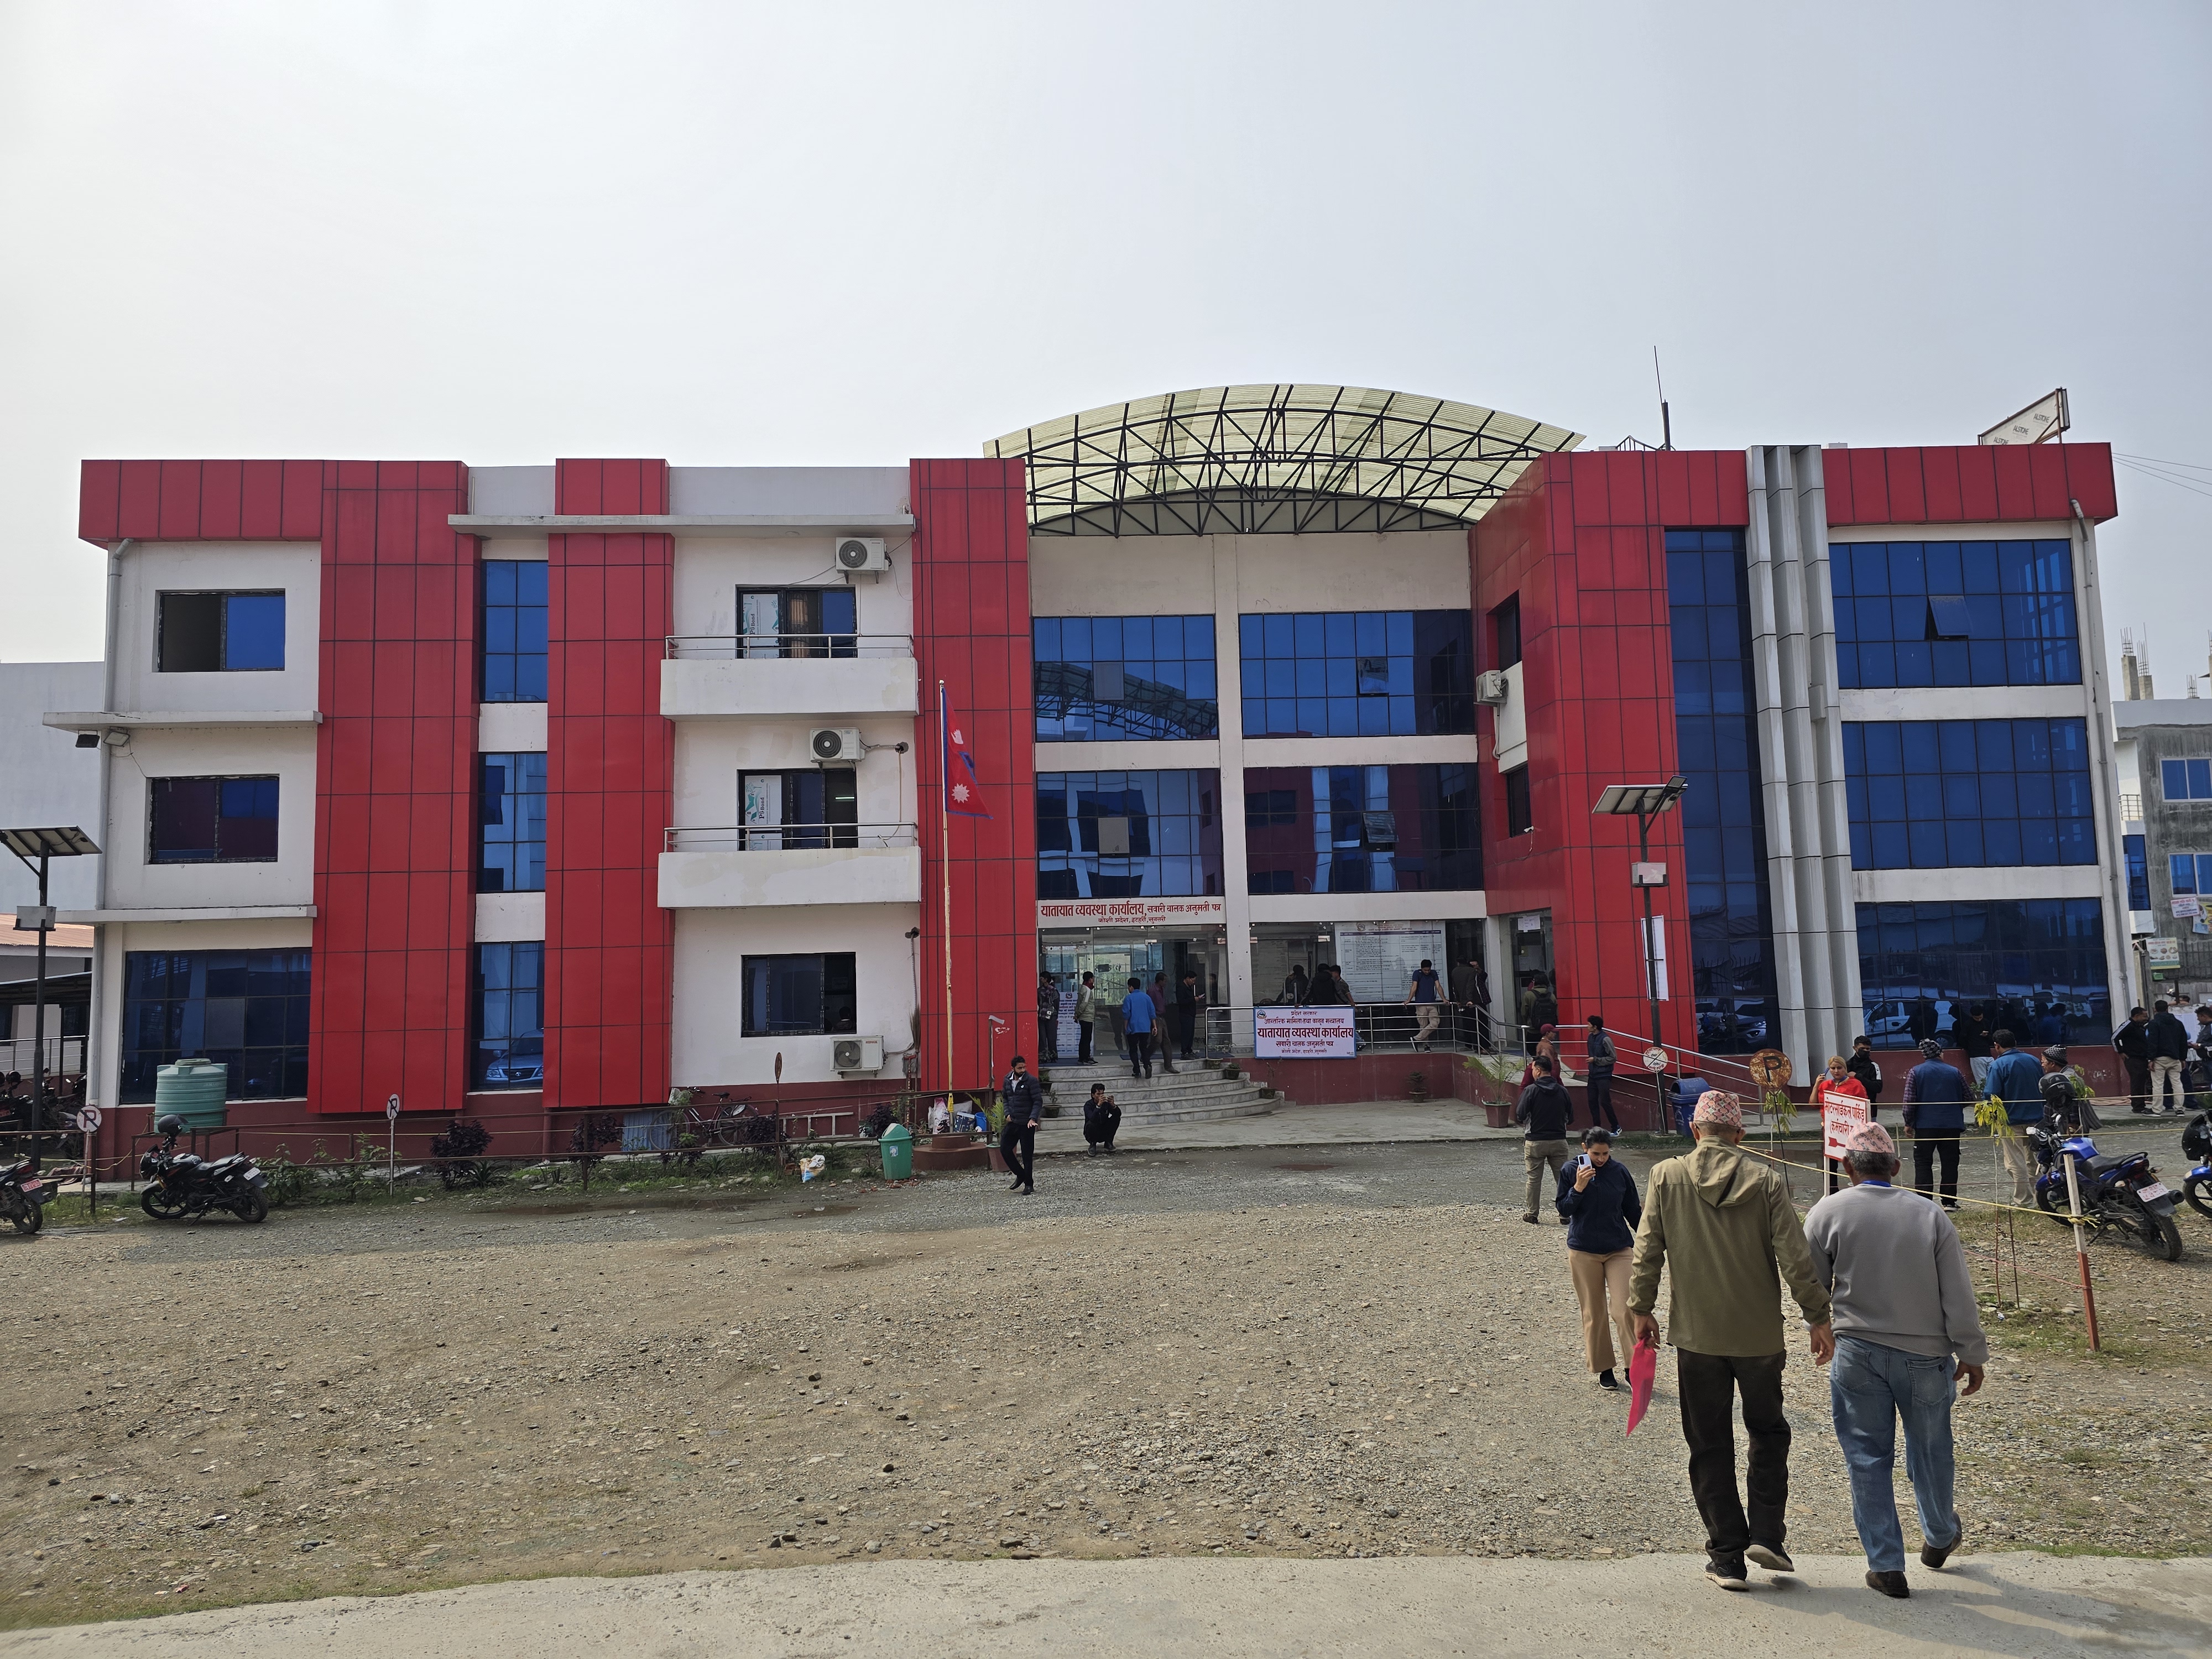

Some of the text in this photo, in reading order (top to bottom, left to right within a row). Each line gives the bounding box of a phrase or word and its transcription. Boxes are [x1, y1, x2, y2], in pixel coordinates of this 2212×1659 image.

[2033, 413, 2050, 423] ALSTONE
[2013, 425, 2029, 435] ALSTONE
[1041, 905, 1074, 917] यातायात
[1075, 904, 1107, 916] व्यवस्था
[1147, 902, 1166, 913] सवारी
[1185, 901, 1210, 915] अनुमती
[1211, 904, 1222, 912] पत्र
[1258, 1025, 1354, 1038] यातायात व्यवस्था कार्यालय
[1763, 1056, 1782, 1082] P
